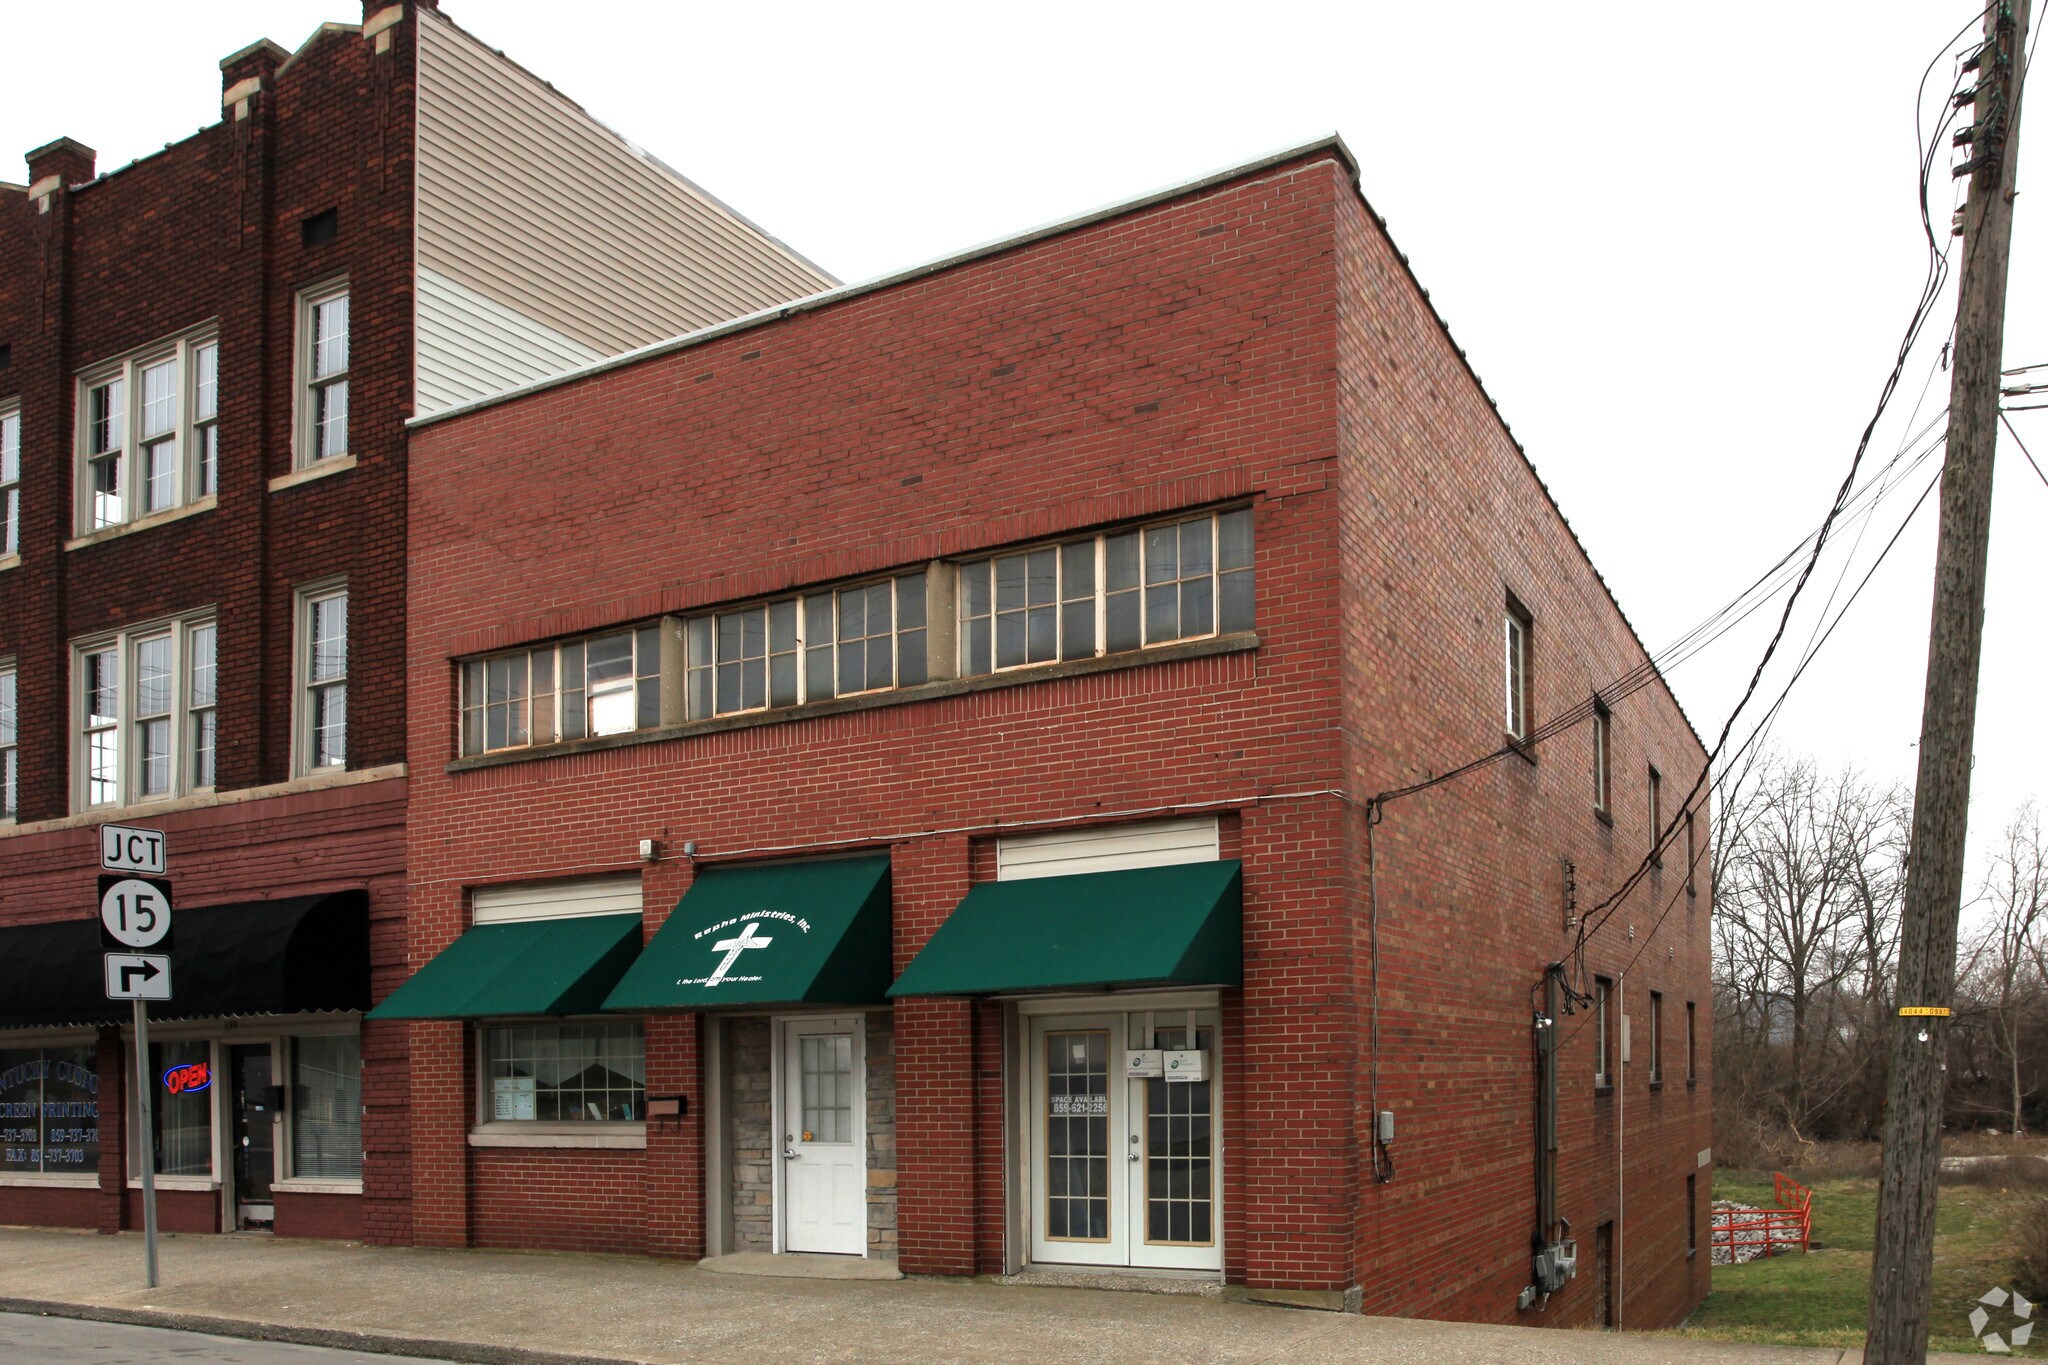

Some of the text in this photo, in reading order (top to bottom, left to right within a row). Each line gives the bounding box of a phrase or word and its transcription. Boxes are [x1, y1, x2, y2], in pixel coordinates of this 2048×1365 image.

[107, 834, 160, 865] JCT
[117, 894, 156, 932] 15
[168, 1062, 207, 1094] OPEN
[43, 1101, 100, 1118] PRINTING
[1051, 1096, 1073, 1104] SPACE
[6, 1148, 84, 1163] FAX: 85-737-3703
